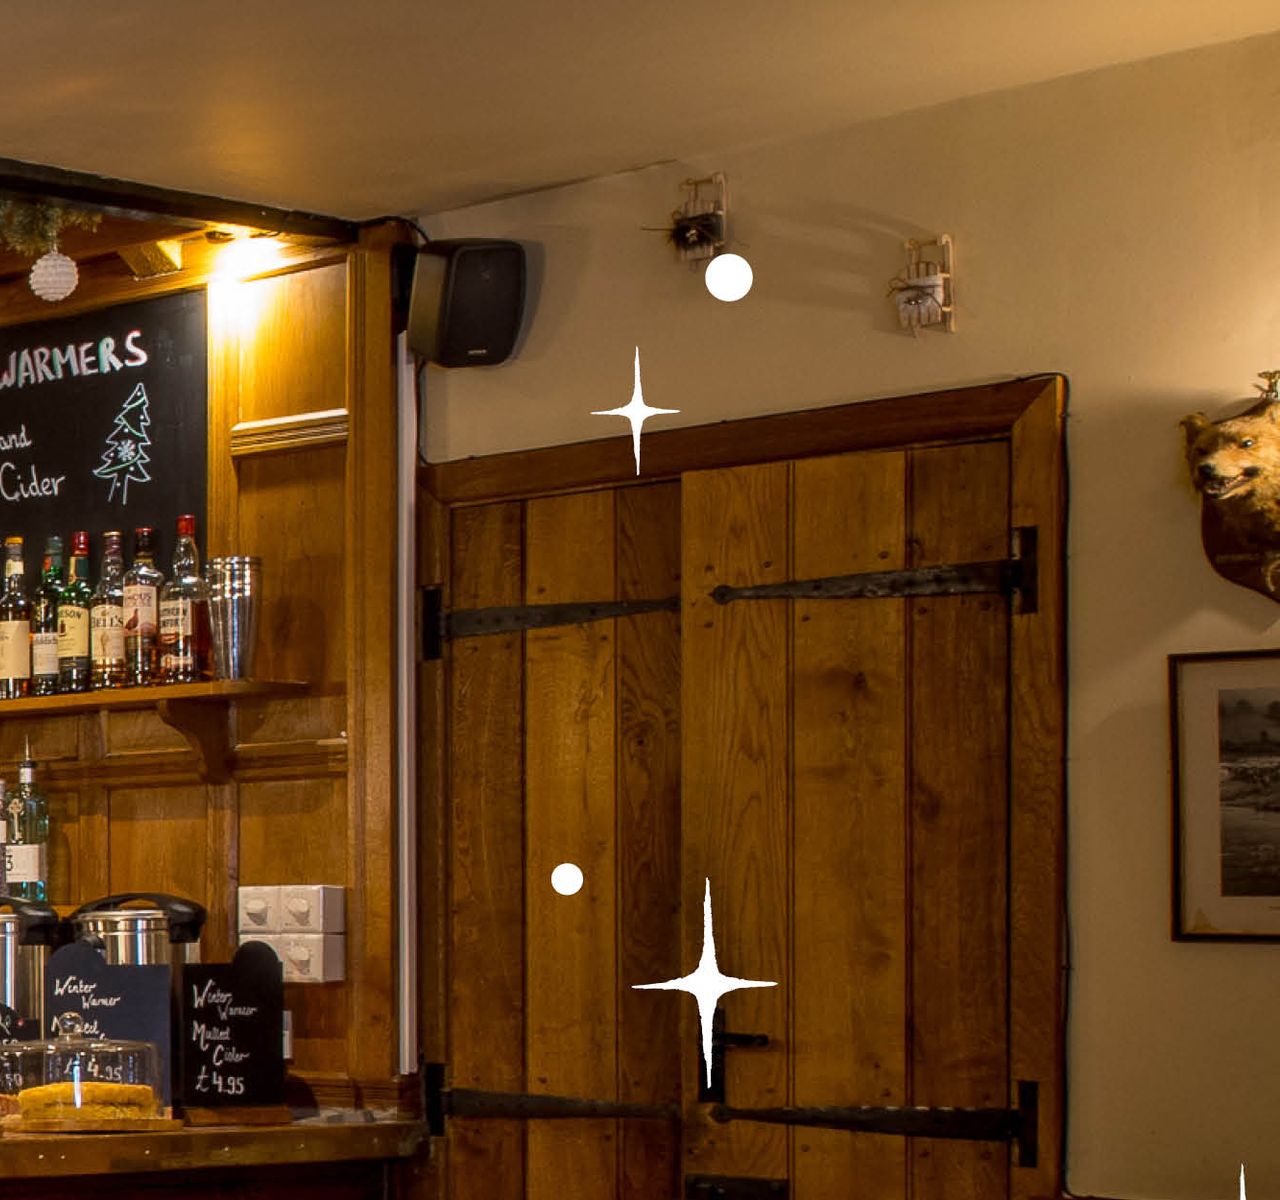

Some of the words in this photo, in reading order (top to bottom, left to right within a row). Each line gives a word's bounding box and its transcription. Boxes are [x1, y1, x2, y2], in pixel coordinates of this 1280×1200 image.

[0, 462, 67, 502] Cider
[54, 976, 97, 997] Winter
[192, 978, 233, 1009] Winter
[192, 1020, 232, 1052] Mulled
[212, 1044, 250, 1067] Cider
